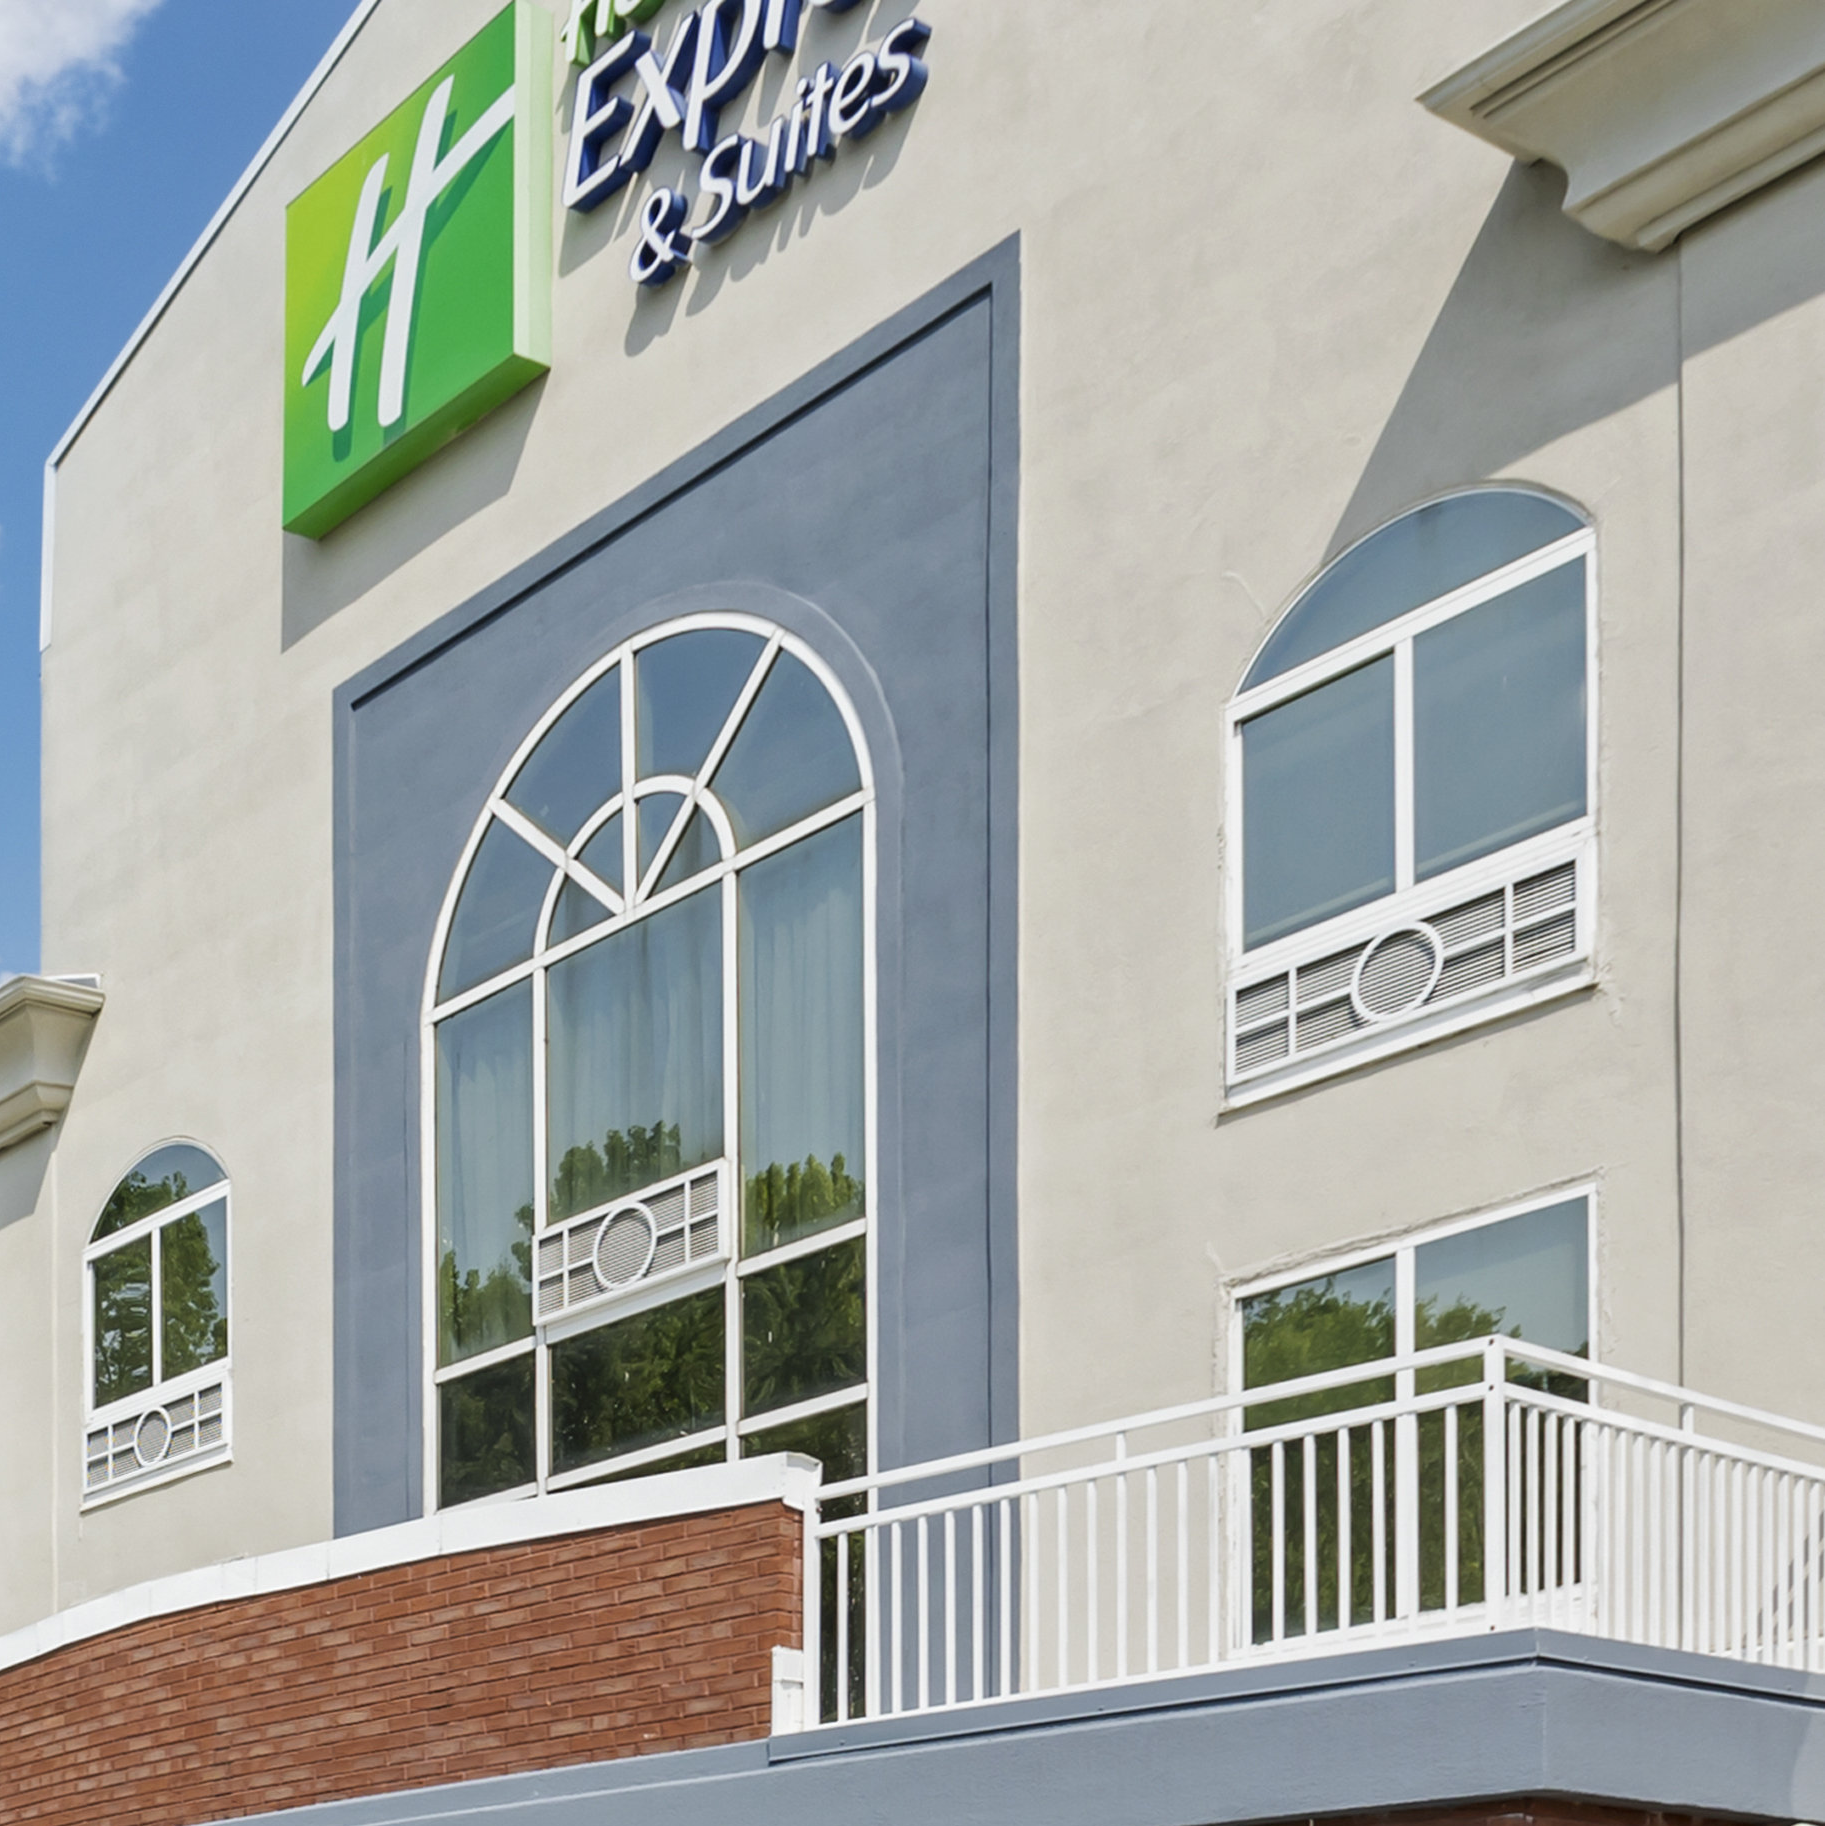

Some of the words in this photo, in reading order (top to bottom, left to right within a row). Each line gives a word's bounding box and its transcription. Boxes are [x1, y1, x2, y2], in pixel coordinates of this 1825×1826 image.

[562, 0, 864, 213] Exp
[629, 186, 691, 286] &
[691, 17, 931, 244] Suites
[302, 74, 515, 432] H
